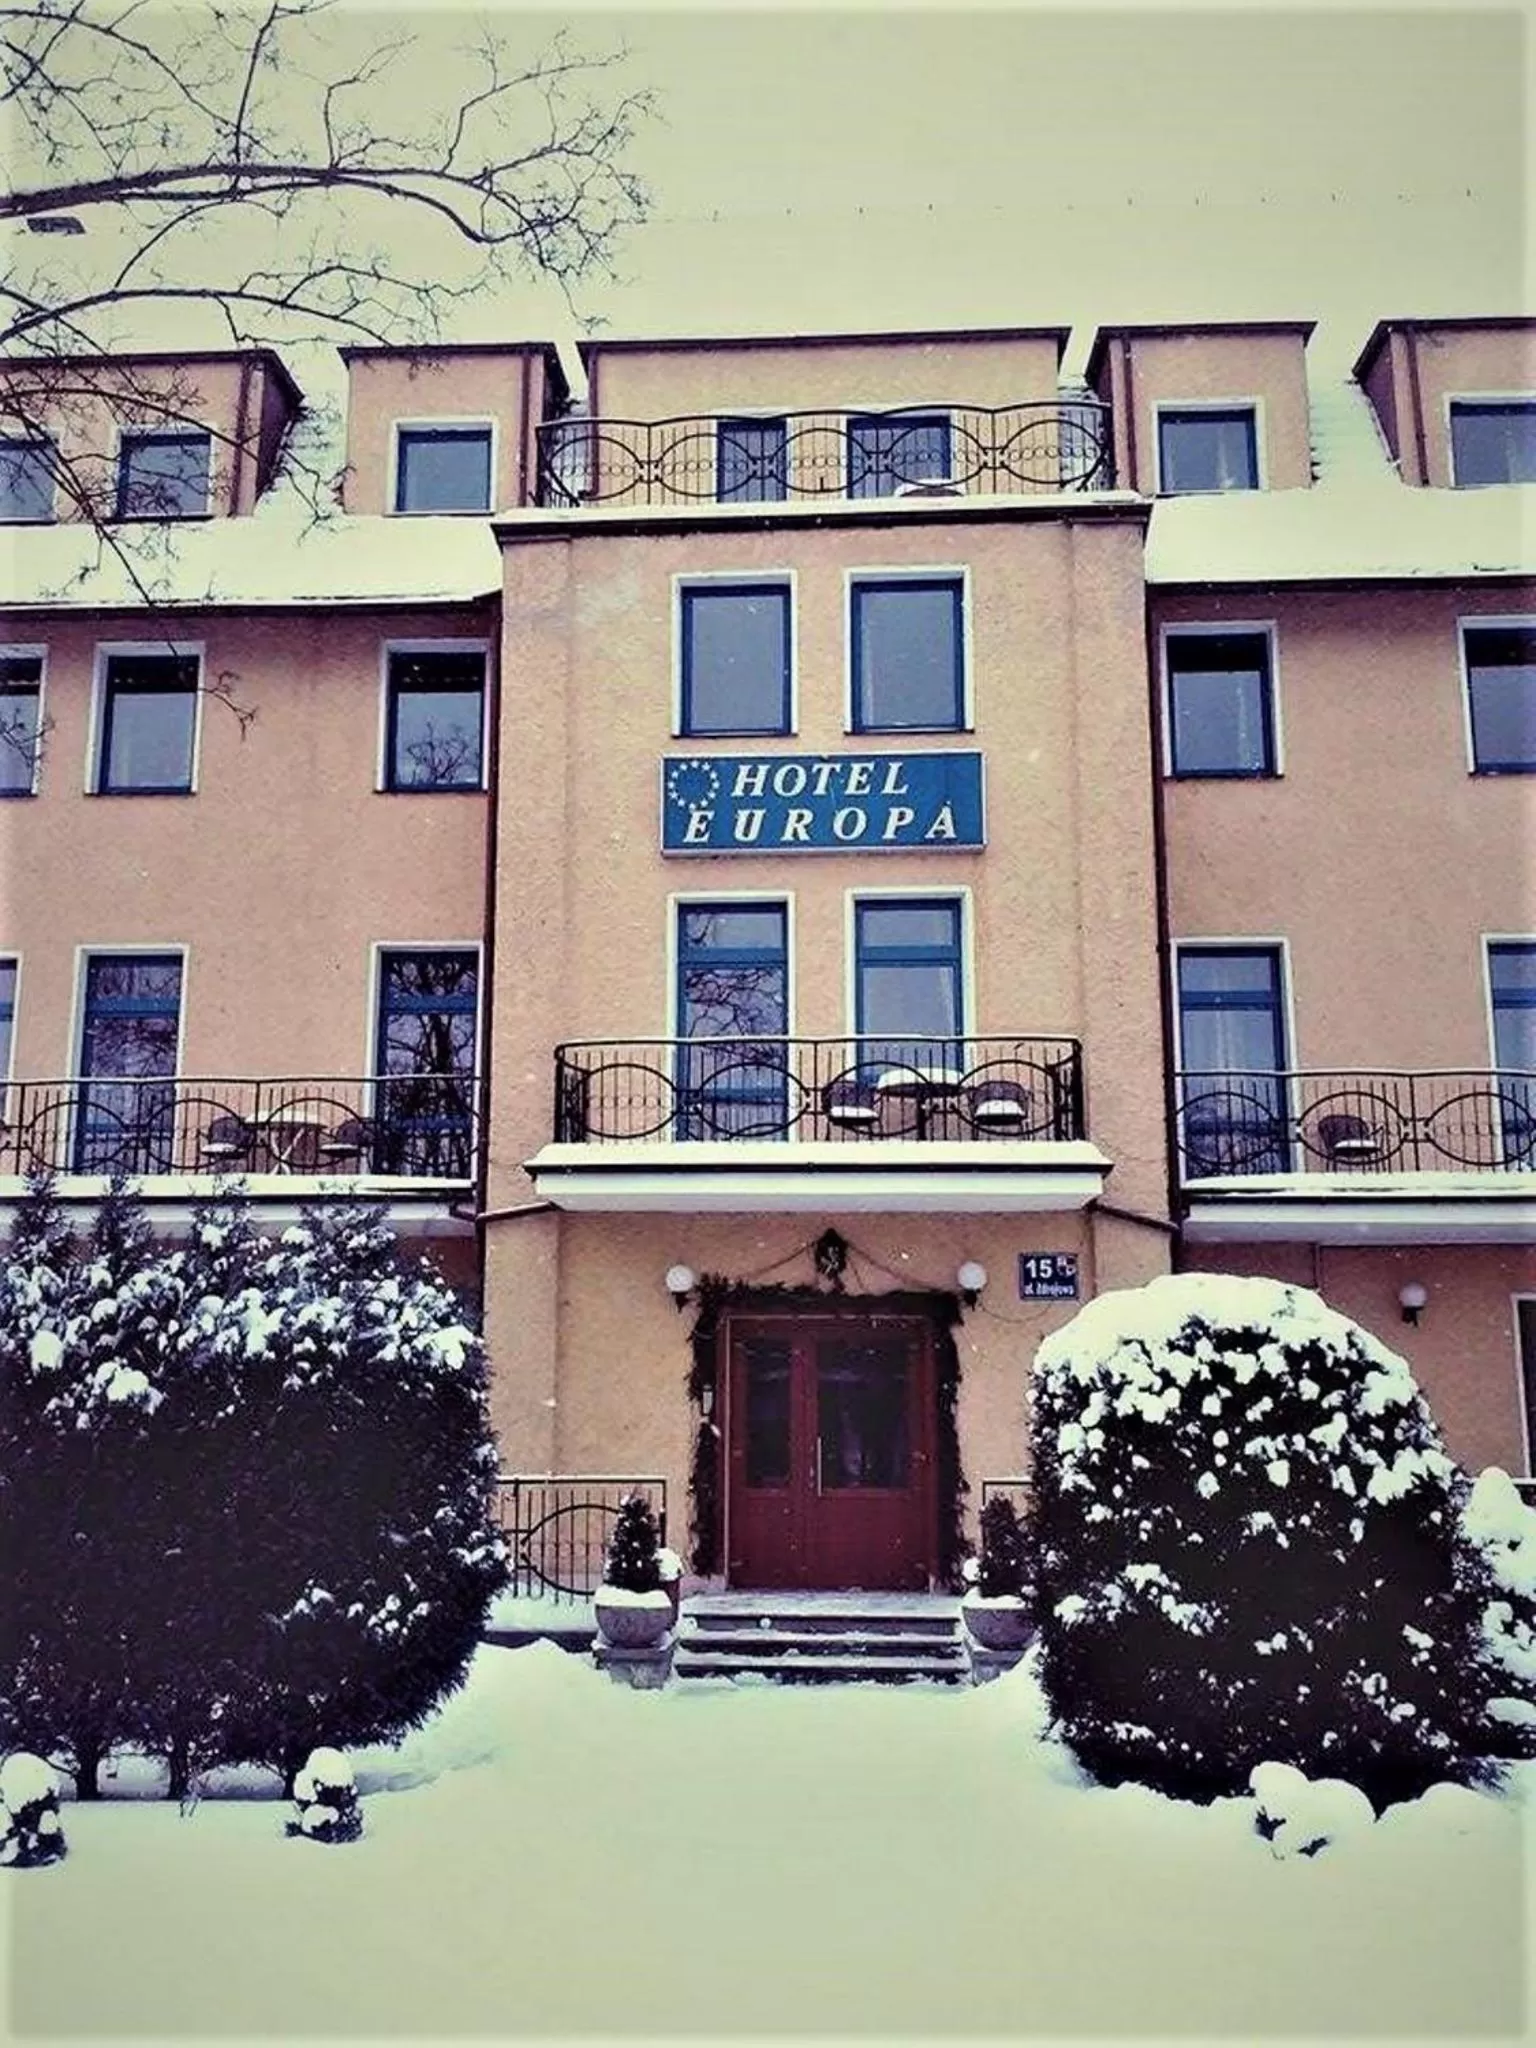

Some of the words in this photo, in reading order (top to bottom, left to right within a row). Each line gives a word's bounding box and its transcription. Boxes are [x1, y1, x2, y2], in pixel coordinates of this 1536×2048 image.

[731, 762, 909, 797] HOTEL
[682, 805, 957, 844] EUROPA
[1025, 1259, 1053, 1278] 15
